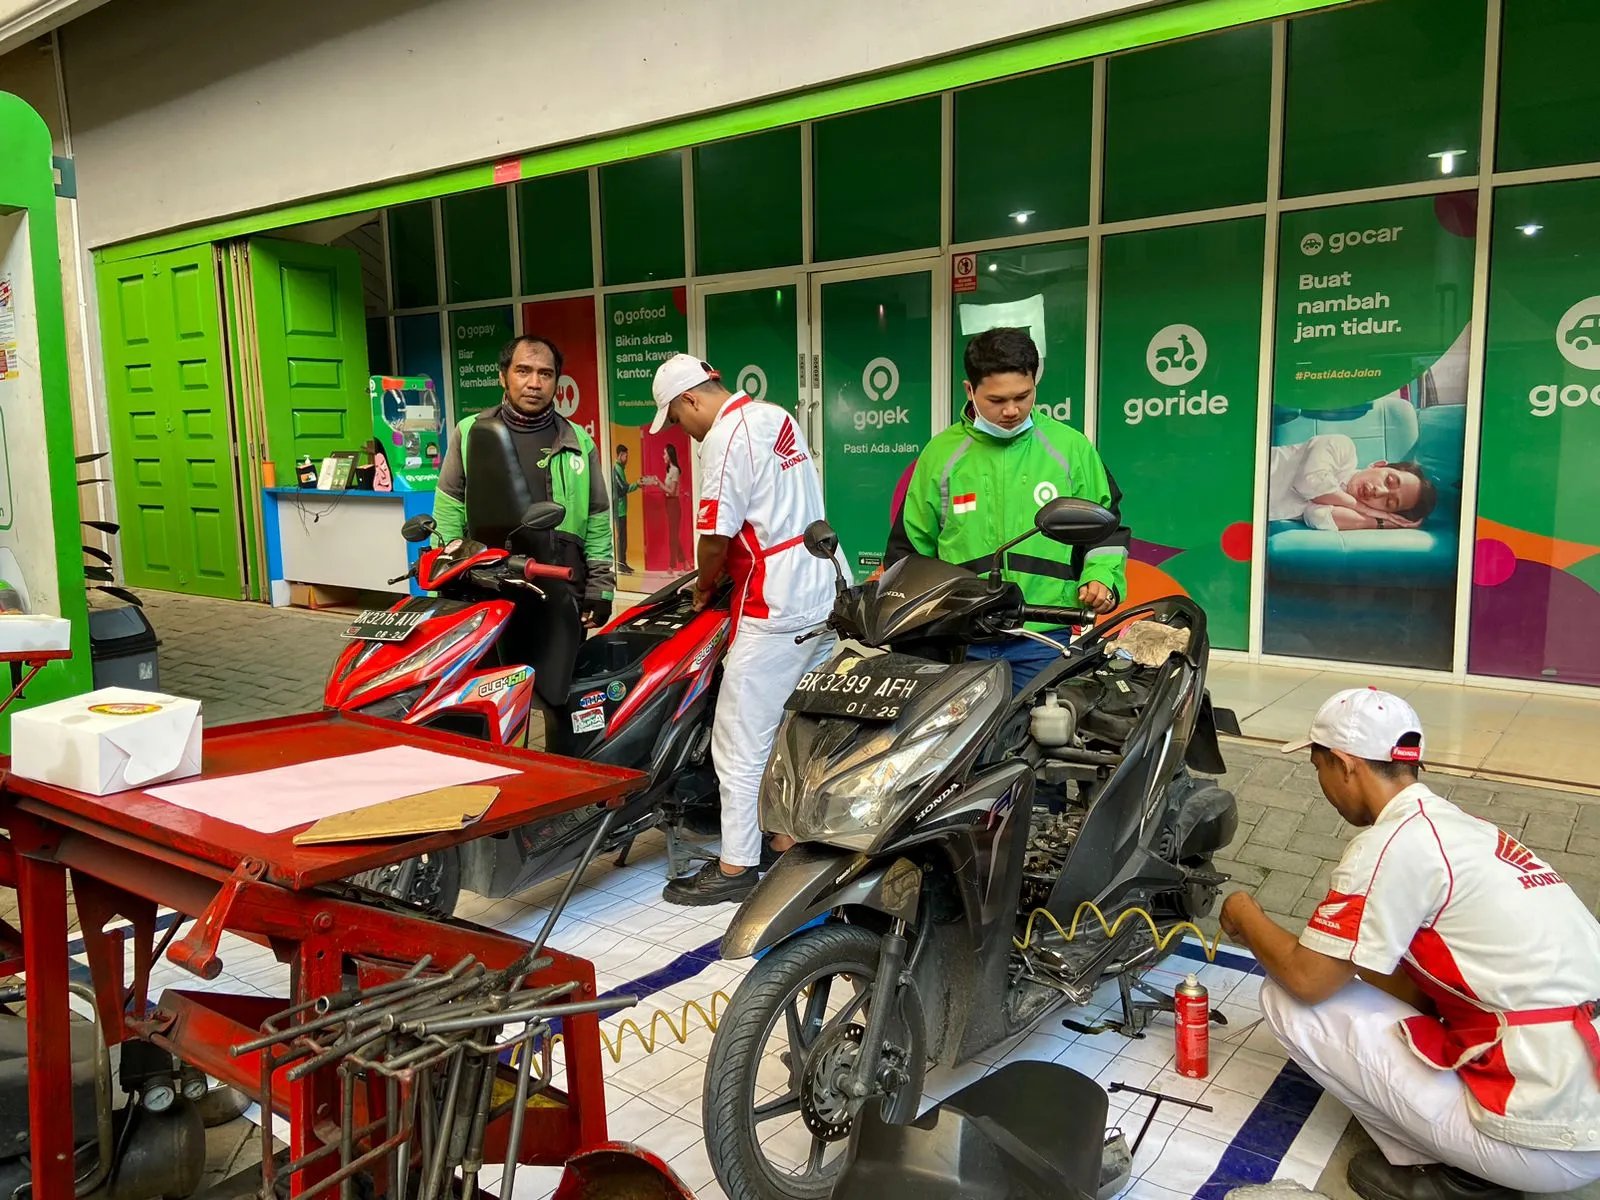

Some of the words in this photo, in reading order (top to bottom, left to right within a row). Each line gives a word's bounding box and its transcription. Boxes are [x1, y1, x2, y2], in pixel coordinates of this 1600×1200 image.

[1328, 226, 1403, 253] gocar
[1299, 271, 1352, 290] Buat
[1297, 292, 1390, 315] nambah
[625, 305, 666, 324] gofood
[467, 324, 495, 339] gopay
[1293, 322, 1336, 343] jam
[1341, 317, 1402, 335] tidur.
[615, 334, 641, 347] Bikin
[642, 332, 673, 345] akrab
[458, 349, 474, 360] Biar
[616, 352, 643, 364] sama
[459, 364, 474, 376] gak
[617, 368, 653, 379] kantor.
[1295, 368, 1382, 380] #PastiAdaJalan
[1124, 390, 1229, 425] goride
[853, 405, 910, 430] gojek
[843, 444, 868, 453] Pasti
[870, 443, 890, 453] Ada
[892, 443, 919, 453] Jalan
[874, 677, 918, 699] AFH
[915, 783, 960, 822] HONDA
[1517, 872, 1565, 890] HOND
